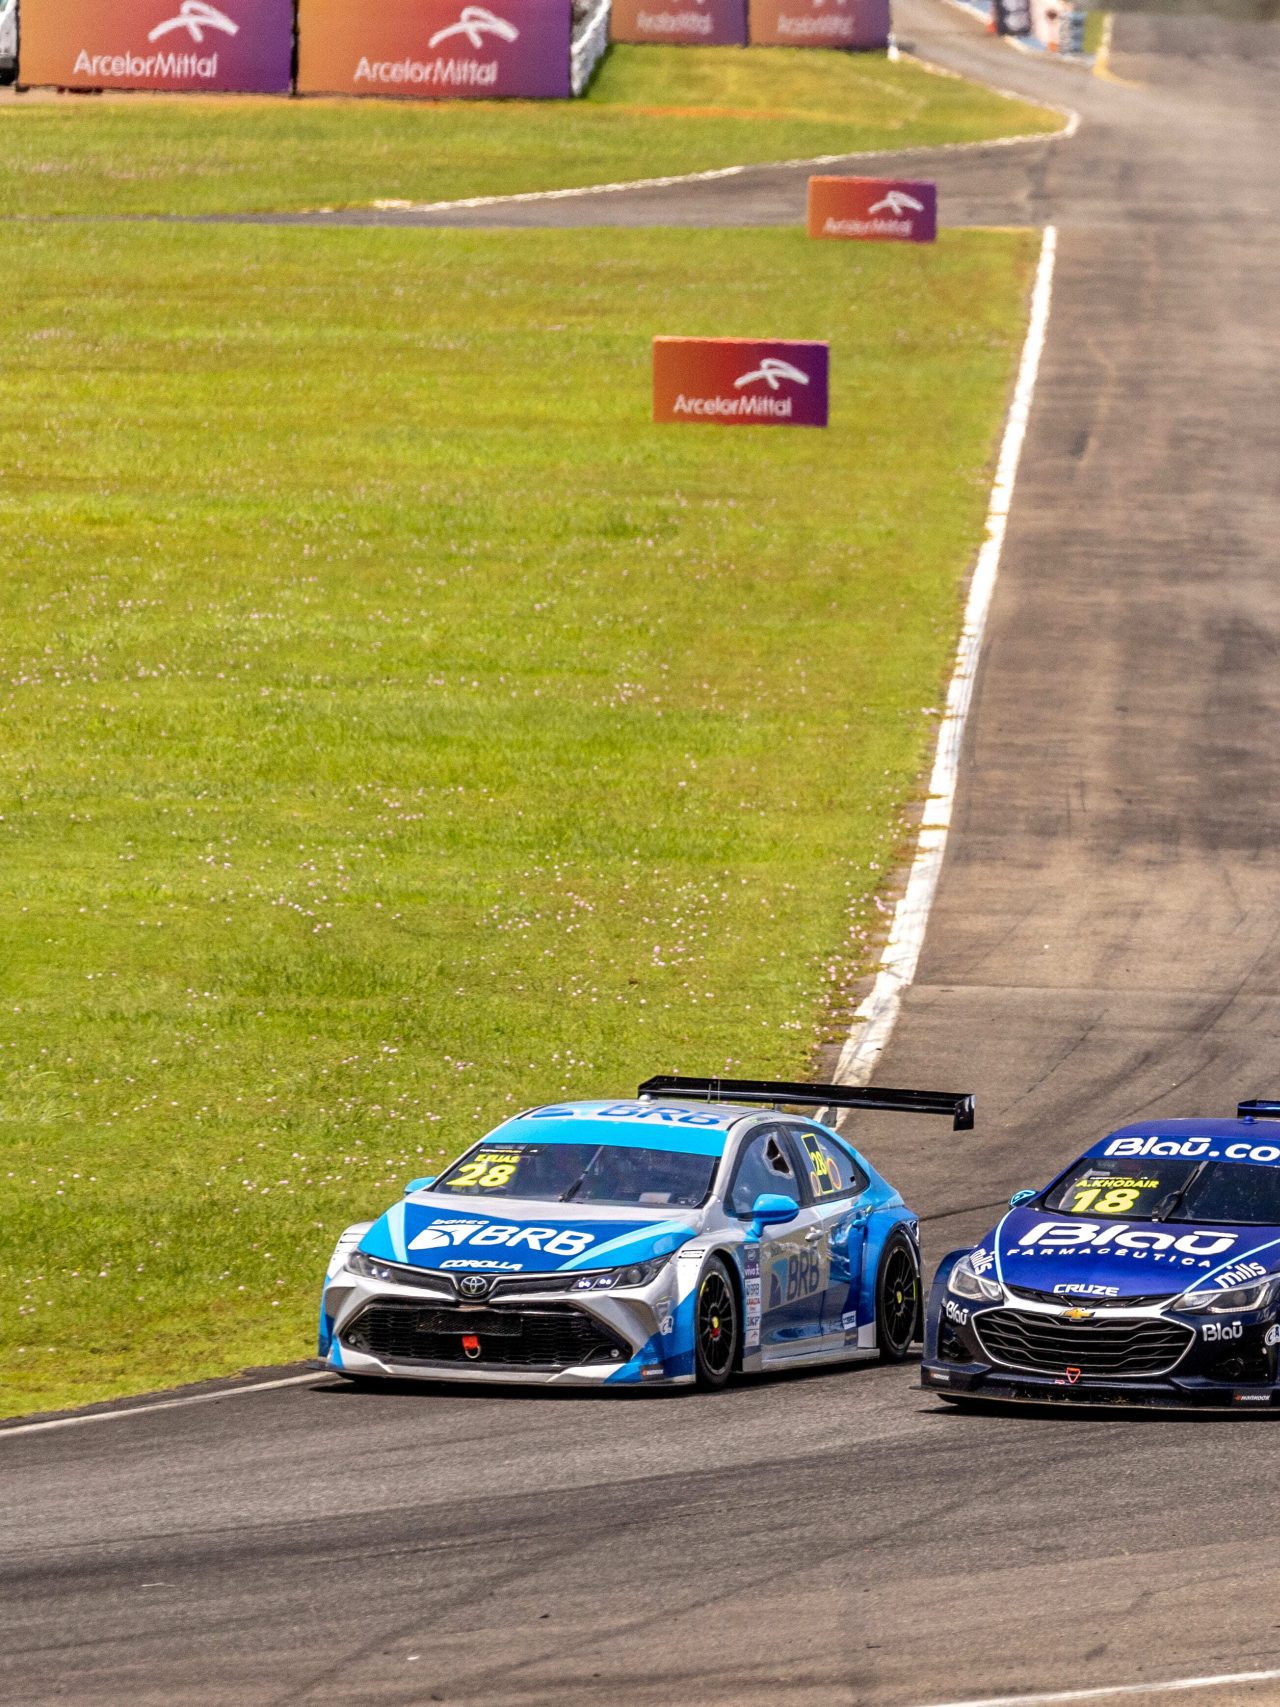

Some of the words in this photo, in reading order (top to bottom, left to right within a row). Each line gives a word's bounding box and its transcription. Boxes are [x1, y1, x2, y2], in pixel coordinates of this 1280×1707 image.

[73, 50, 218, 79] ArcelorMittal
[353, 57, 498, 86] ArcelorMittal
[673, 394, 792, 419] ArcelorMittal
[597, 1104, 731, 1126] BRB
[446, 1163, 517, 1188] 28
[809, 1150, 828, 1177] 28
[1075, 1179, 1160, 1189] A.KHODAIR
[1071, 1188, 1140, 1213] 18
[431, 1218, 491, 1226] banco
[468, 1225, 596, 1257] BRB
[439, 1259, 524, 1272] COROLLA
[787, 1249, 820, 1301] BRB
[1214, 1261, 1267, 1290] mills
[1053, 1283, 1120, 1297] CRUZE
